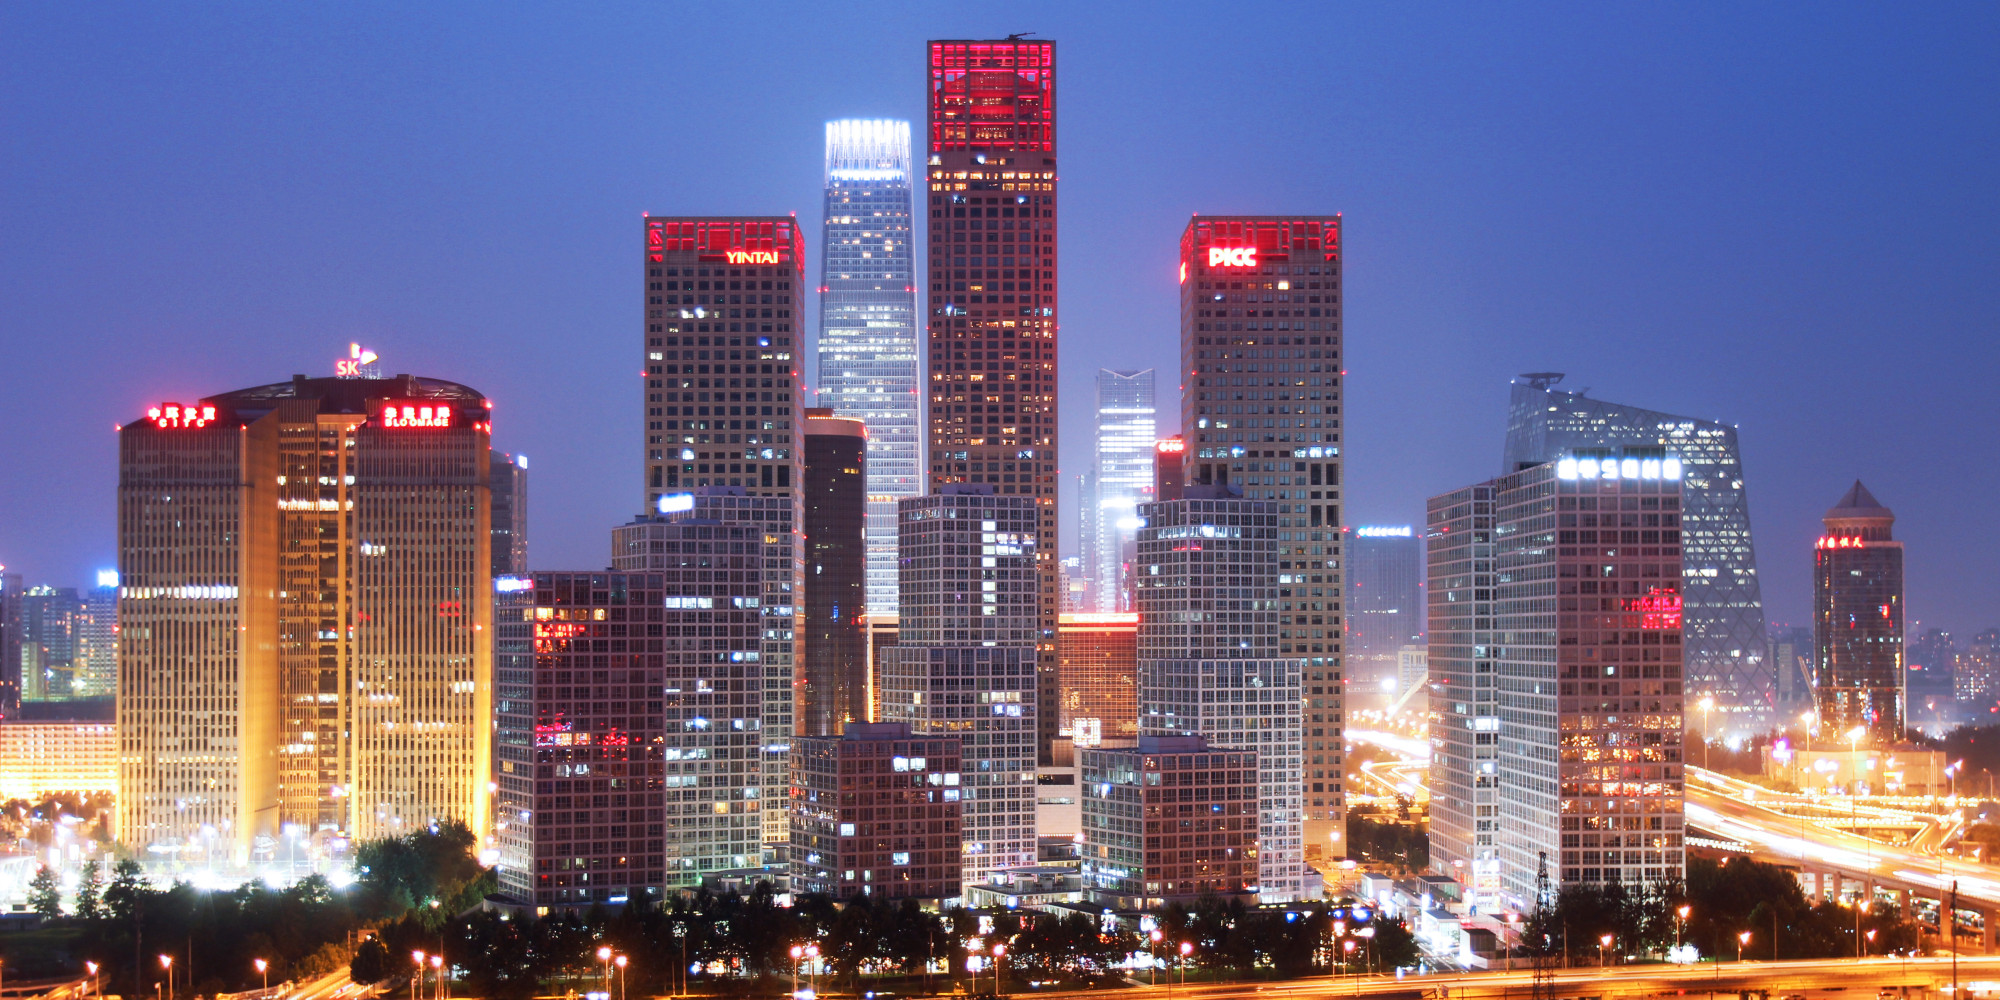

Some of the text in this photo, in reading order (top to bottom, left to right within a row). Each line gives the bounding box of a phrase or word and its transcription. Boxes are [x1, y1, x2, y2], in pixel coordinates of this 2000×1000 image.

[726, 251, 778, 264] YINTAI
[1209, 248, 1256, 267] PICC
[337, 360, 360, 376] SK
[159, 418, 205, 428] CITC
[385, 418, 449, 427] BLOOMAGE
